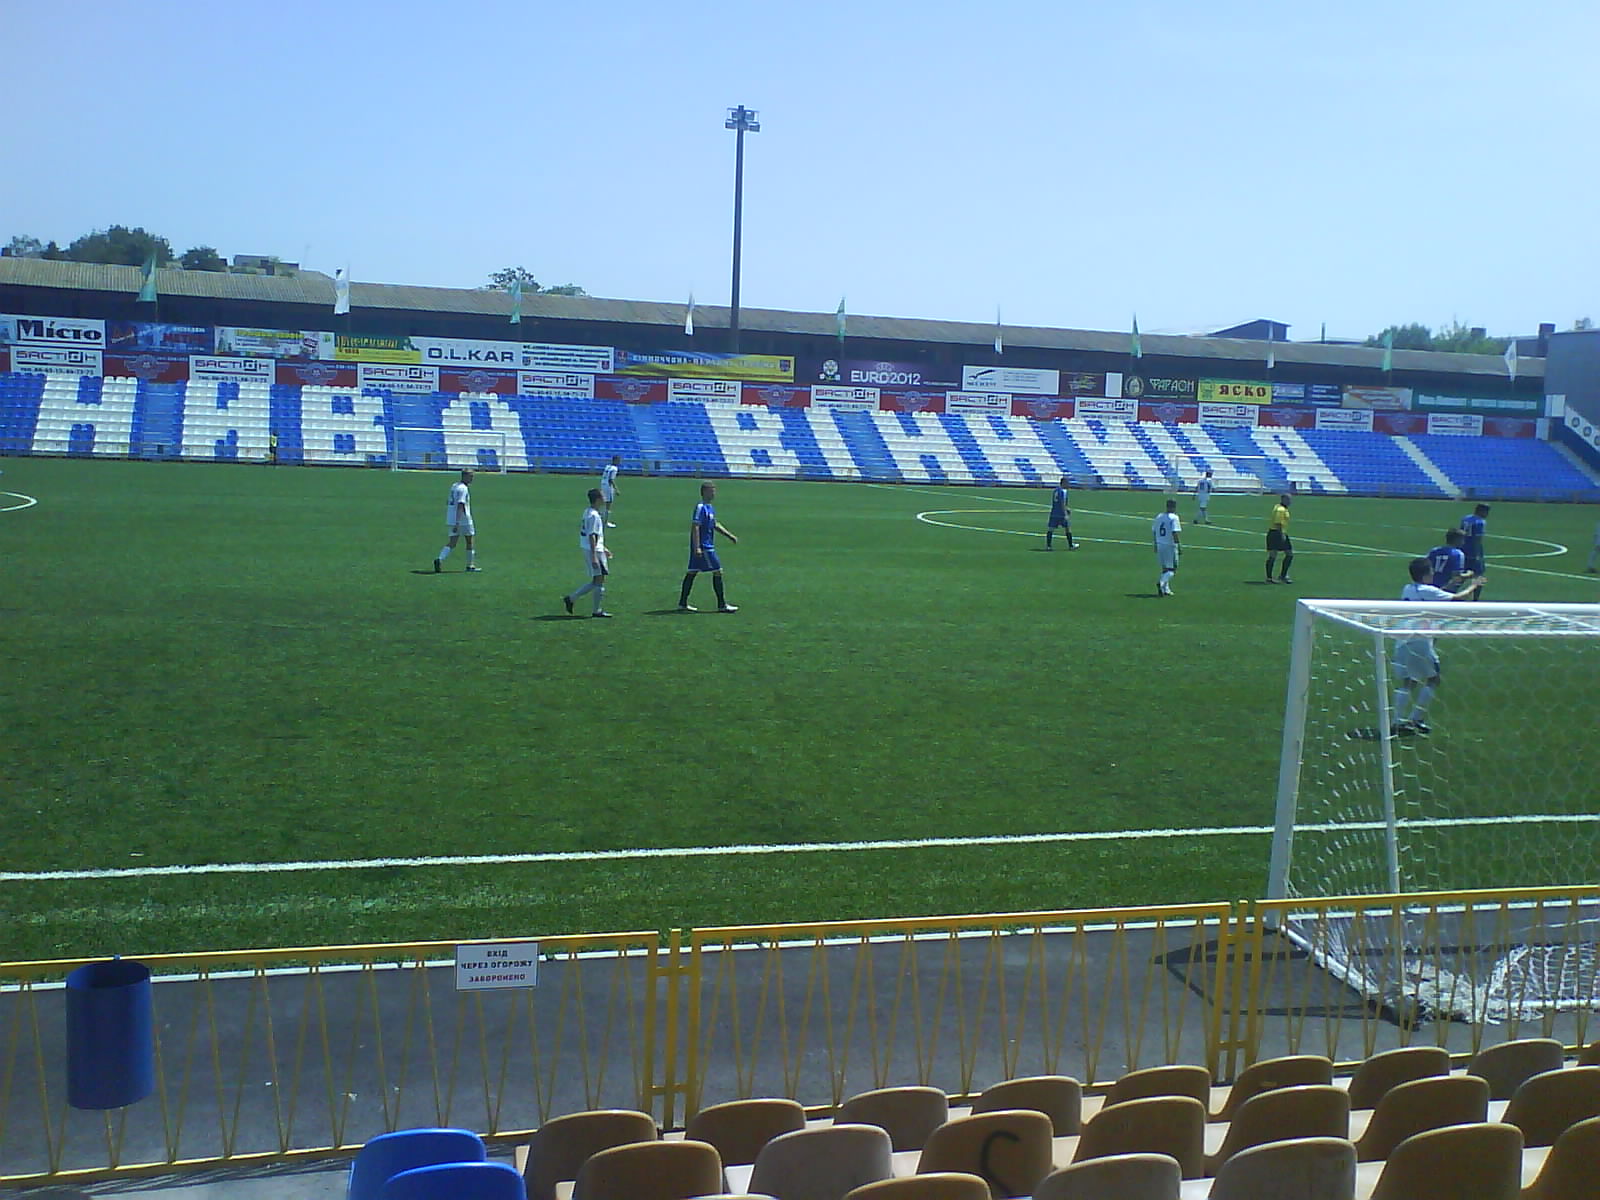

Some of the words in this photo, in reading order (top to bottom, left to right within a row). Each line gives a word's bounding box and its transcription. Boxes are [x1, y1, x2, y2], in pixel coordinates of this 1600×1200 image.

[428, 347, 514, 362] O.L.KAR
[850, 370, 921, 385] EURO2012
[1219, 384, 1267, 397] ЯСКО
[461, 961, 489, 970] ЧЕРЕЗ
[490, 960, 533, 969] ОГОРОЖУ
[468, 973, 527, 983] ЗАБОРОНЕНО
